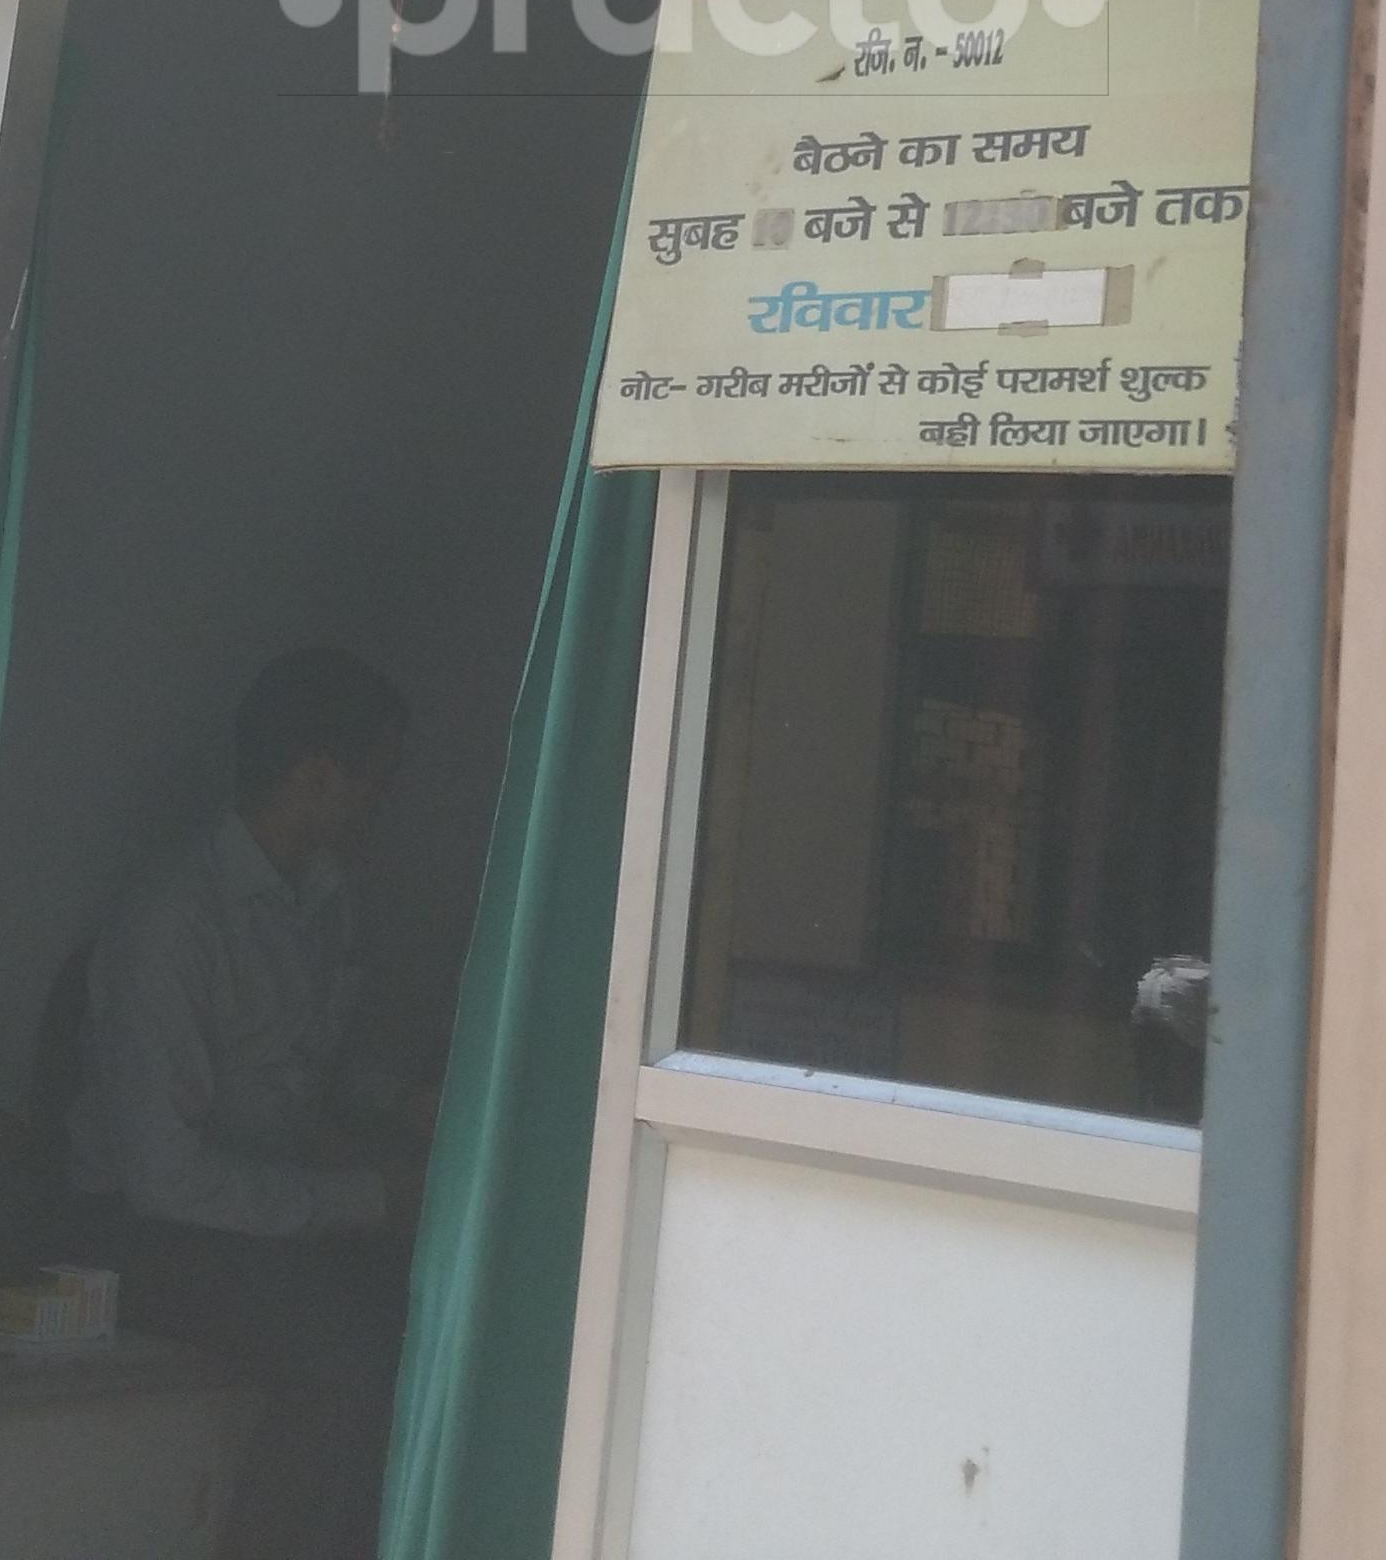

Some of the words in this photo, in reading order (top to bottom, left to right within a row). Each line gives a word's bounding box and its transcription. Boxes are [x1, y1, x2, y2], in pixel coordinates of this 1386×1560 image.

[953, 28, 1004, 68] 50012
[793, 132, 888, 175] बैठने
[899, 134, 962, 168] का
[972, 125, 1091, 163] समय
[648, 213, 746, 266] सुबह
[804, 196, 877, 243] बजे
[887, 192, 931, 240] से
[1062, 179, 1143, 230] बजे
[1155, 185, 1250, 226] तक
[748, 280, 932, 334] रविवार
[695, 366, 772, 398] गरीब
[778, 361, 875, 397] मरीजों
[878, 363, 910, 395] से
[917, 360, 989, 398] कोई
[996, 357, 1112, 393] परामर्श
[1120, 366, 1211, 402] शुल्क
[919, 412, 981, 447] नही
[989, 412, 1070, 446] लिया
